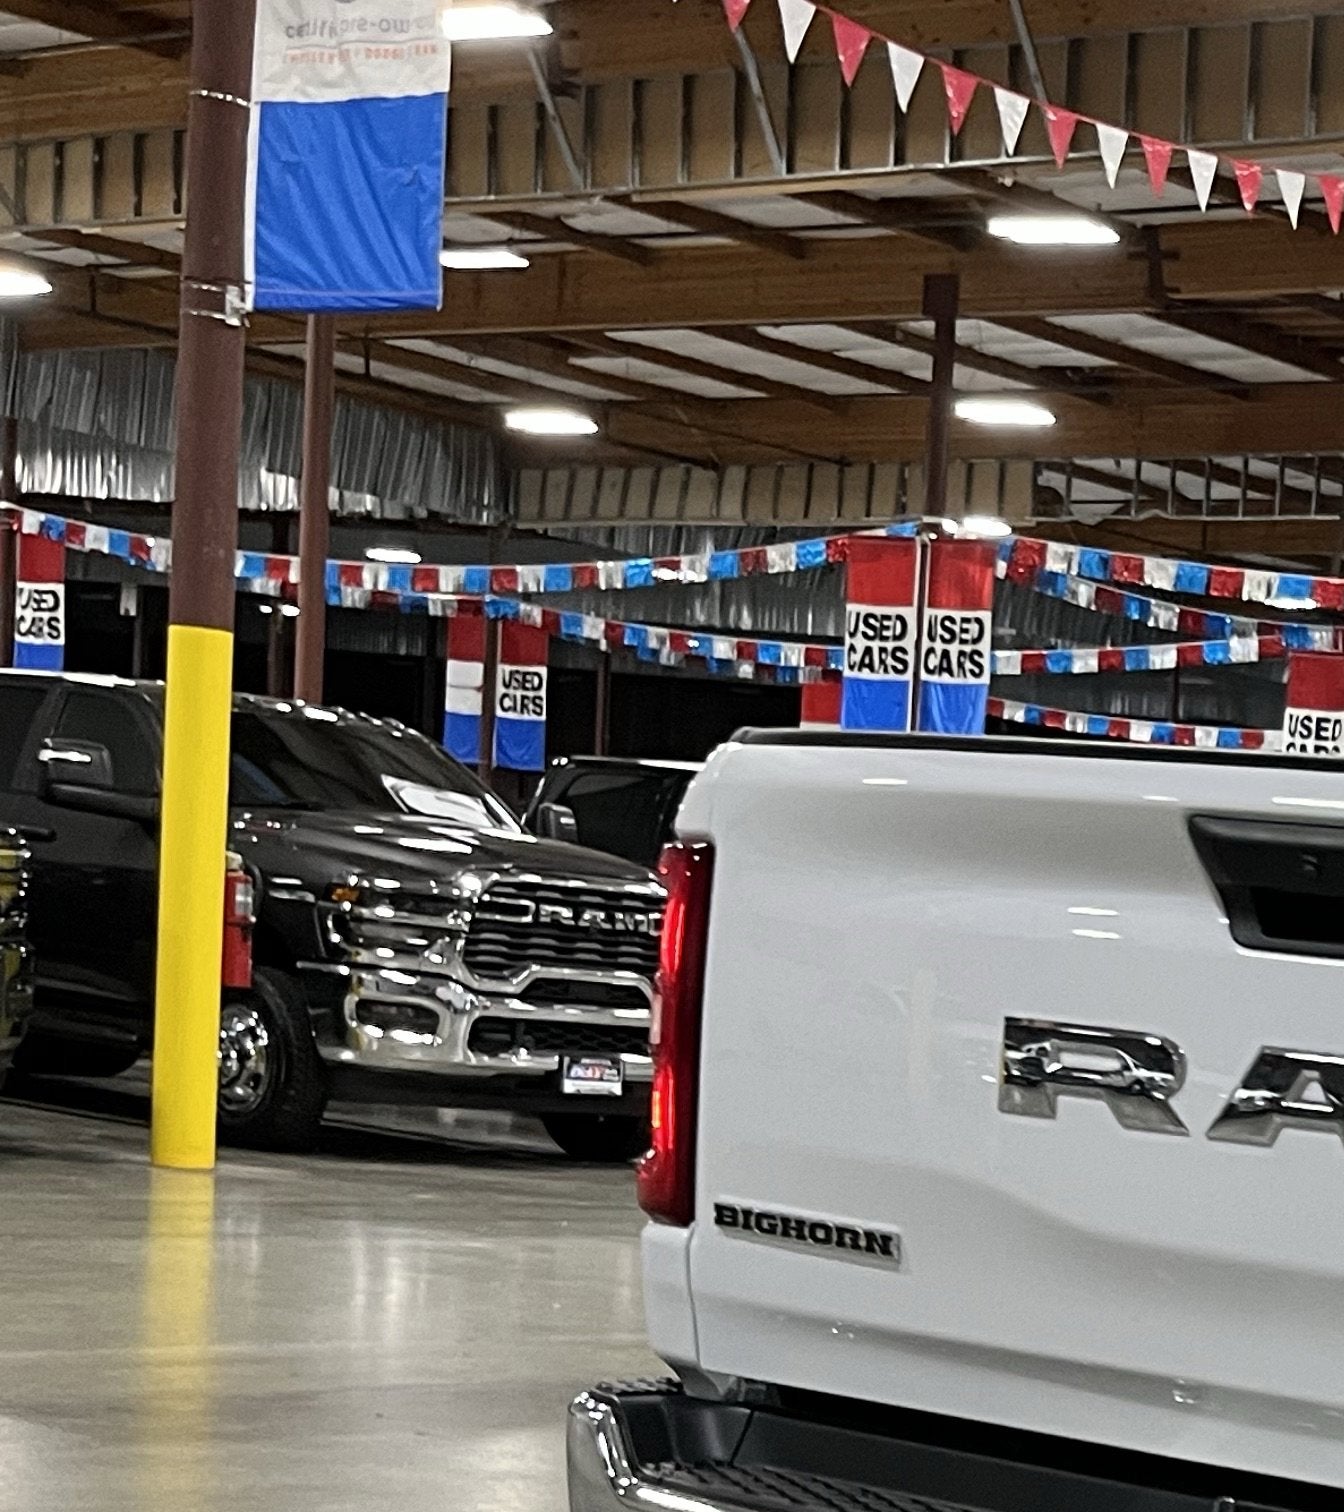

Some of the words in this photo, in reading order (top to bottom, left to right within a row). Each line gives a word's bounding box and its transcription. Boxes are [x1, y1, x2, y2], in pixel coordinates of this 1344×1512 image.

[848, 611, 909, 643] USED
[926, 614, 985, 645] USED
[847, 642, 909, 675] CARS
[923, 646, 984, 678] CARS
[502, 668, 543, 692] USED
[1288, 713, 1343, 742] USED
[538, 904, 649, 933] RAM
[713, 1201, 896, 1258] BIGHORN
